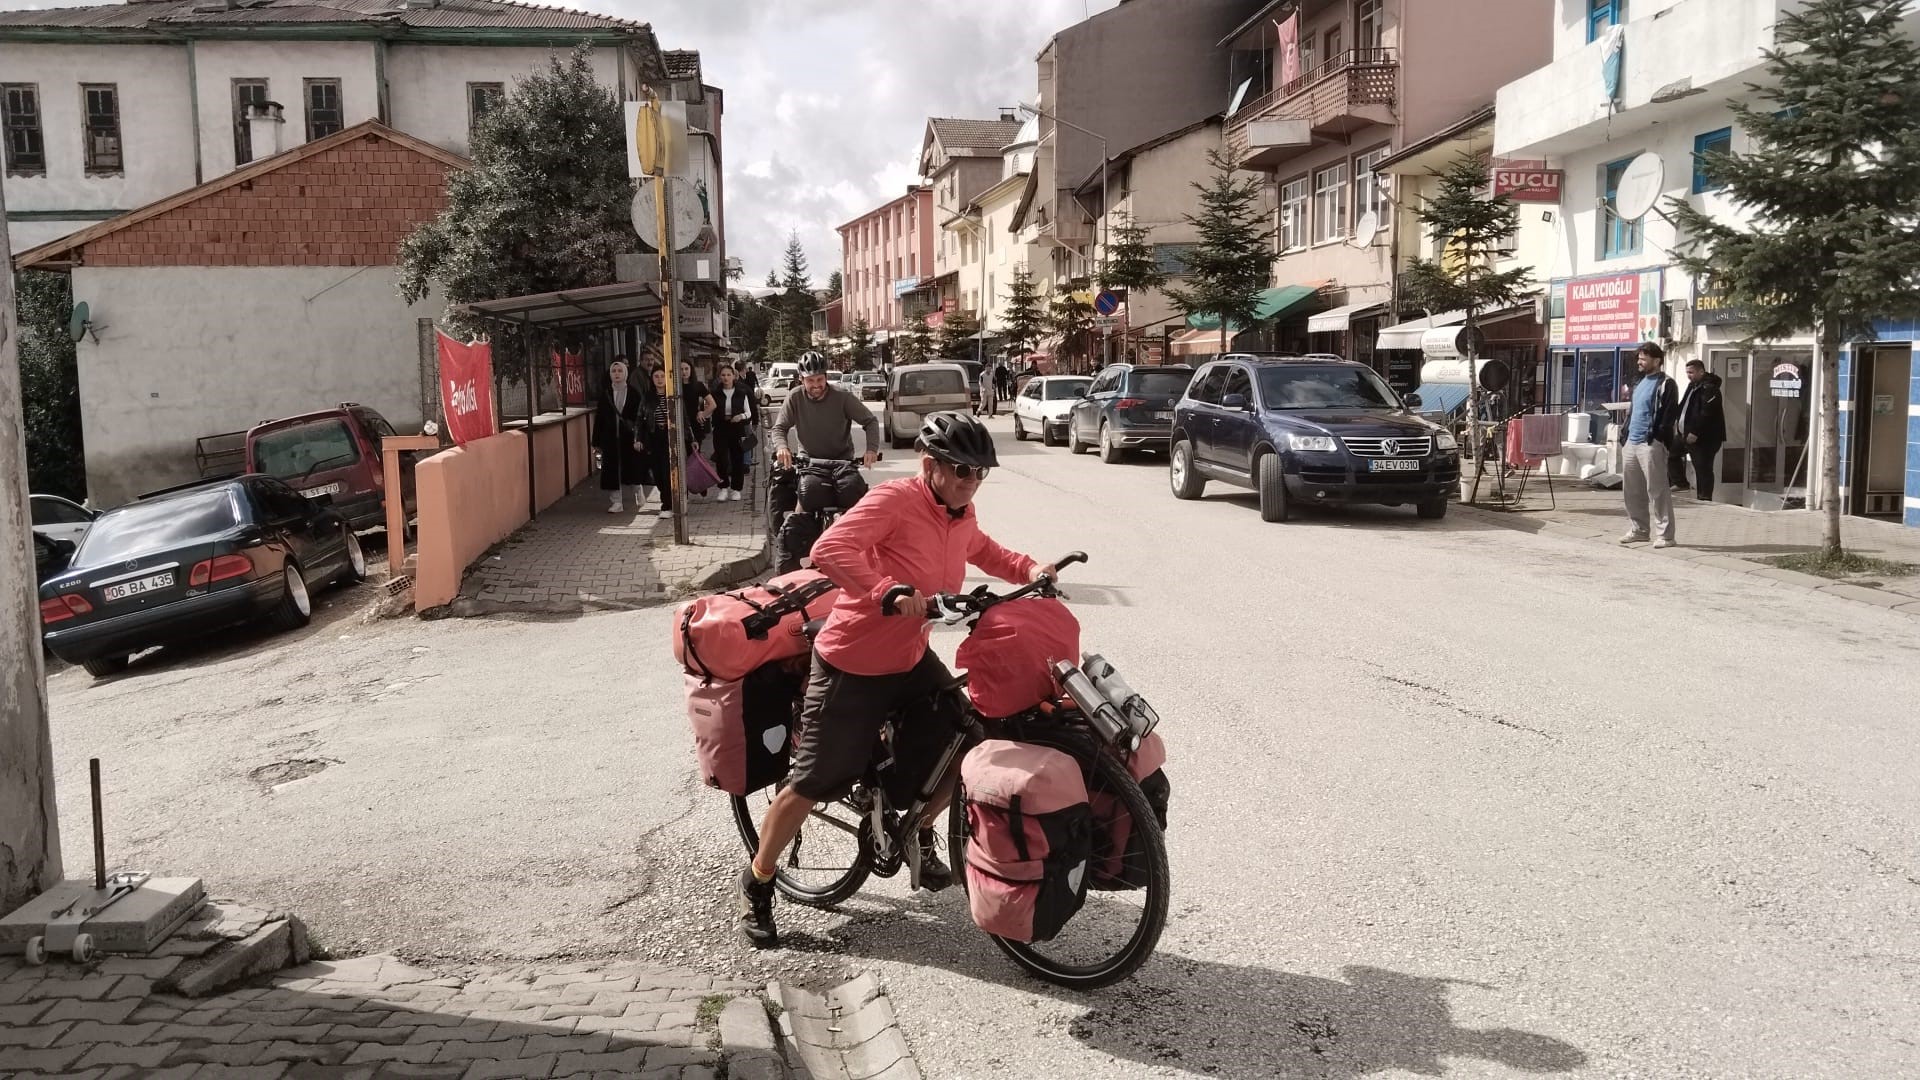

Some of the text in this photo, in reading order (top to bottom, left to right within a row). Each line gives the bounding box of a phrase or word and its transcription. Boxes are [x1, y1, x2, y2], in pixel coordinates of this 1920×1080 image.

[1498, 172, 1559, 188] SUCU
[1572, 278, 1633, 300] KALAYCIOĞLU
[1597, 297, 1620, 310] TESİSAT
[1373, 460, 1418, 470] 34 EV 0310
[323, 484, 338, 493] 270
[59, 579, 82, 589] E200
[111, 573, 173, 598] 06 BA 435
